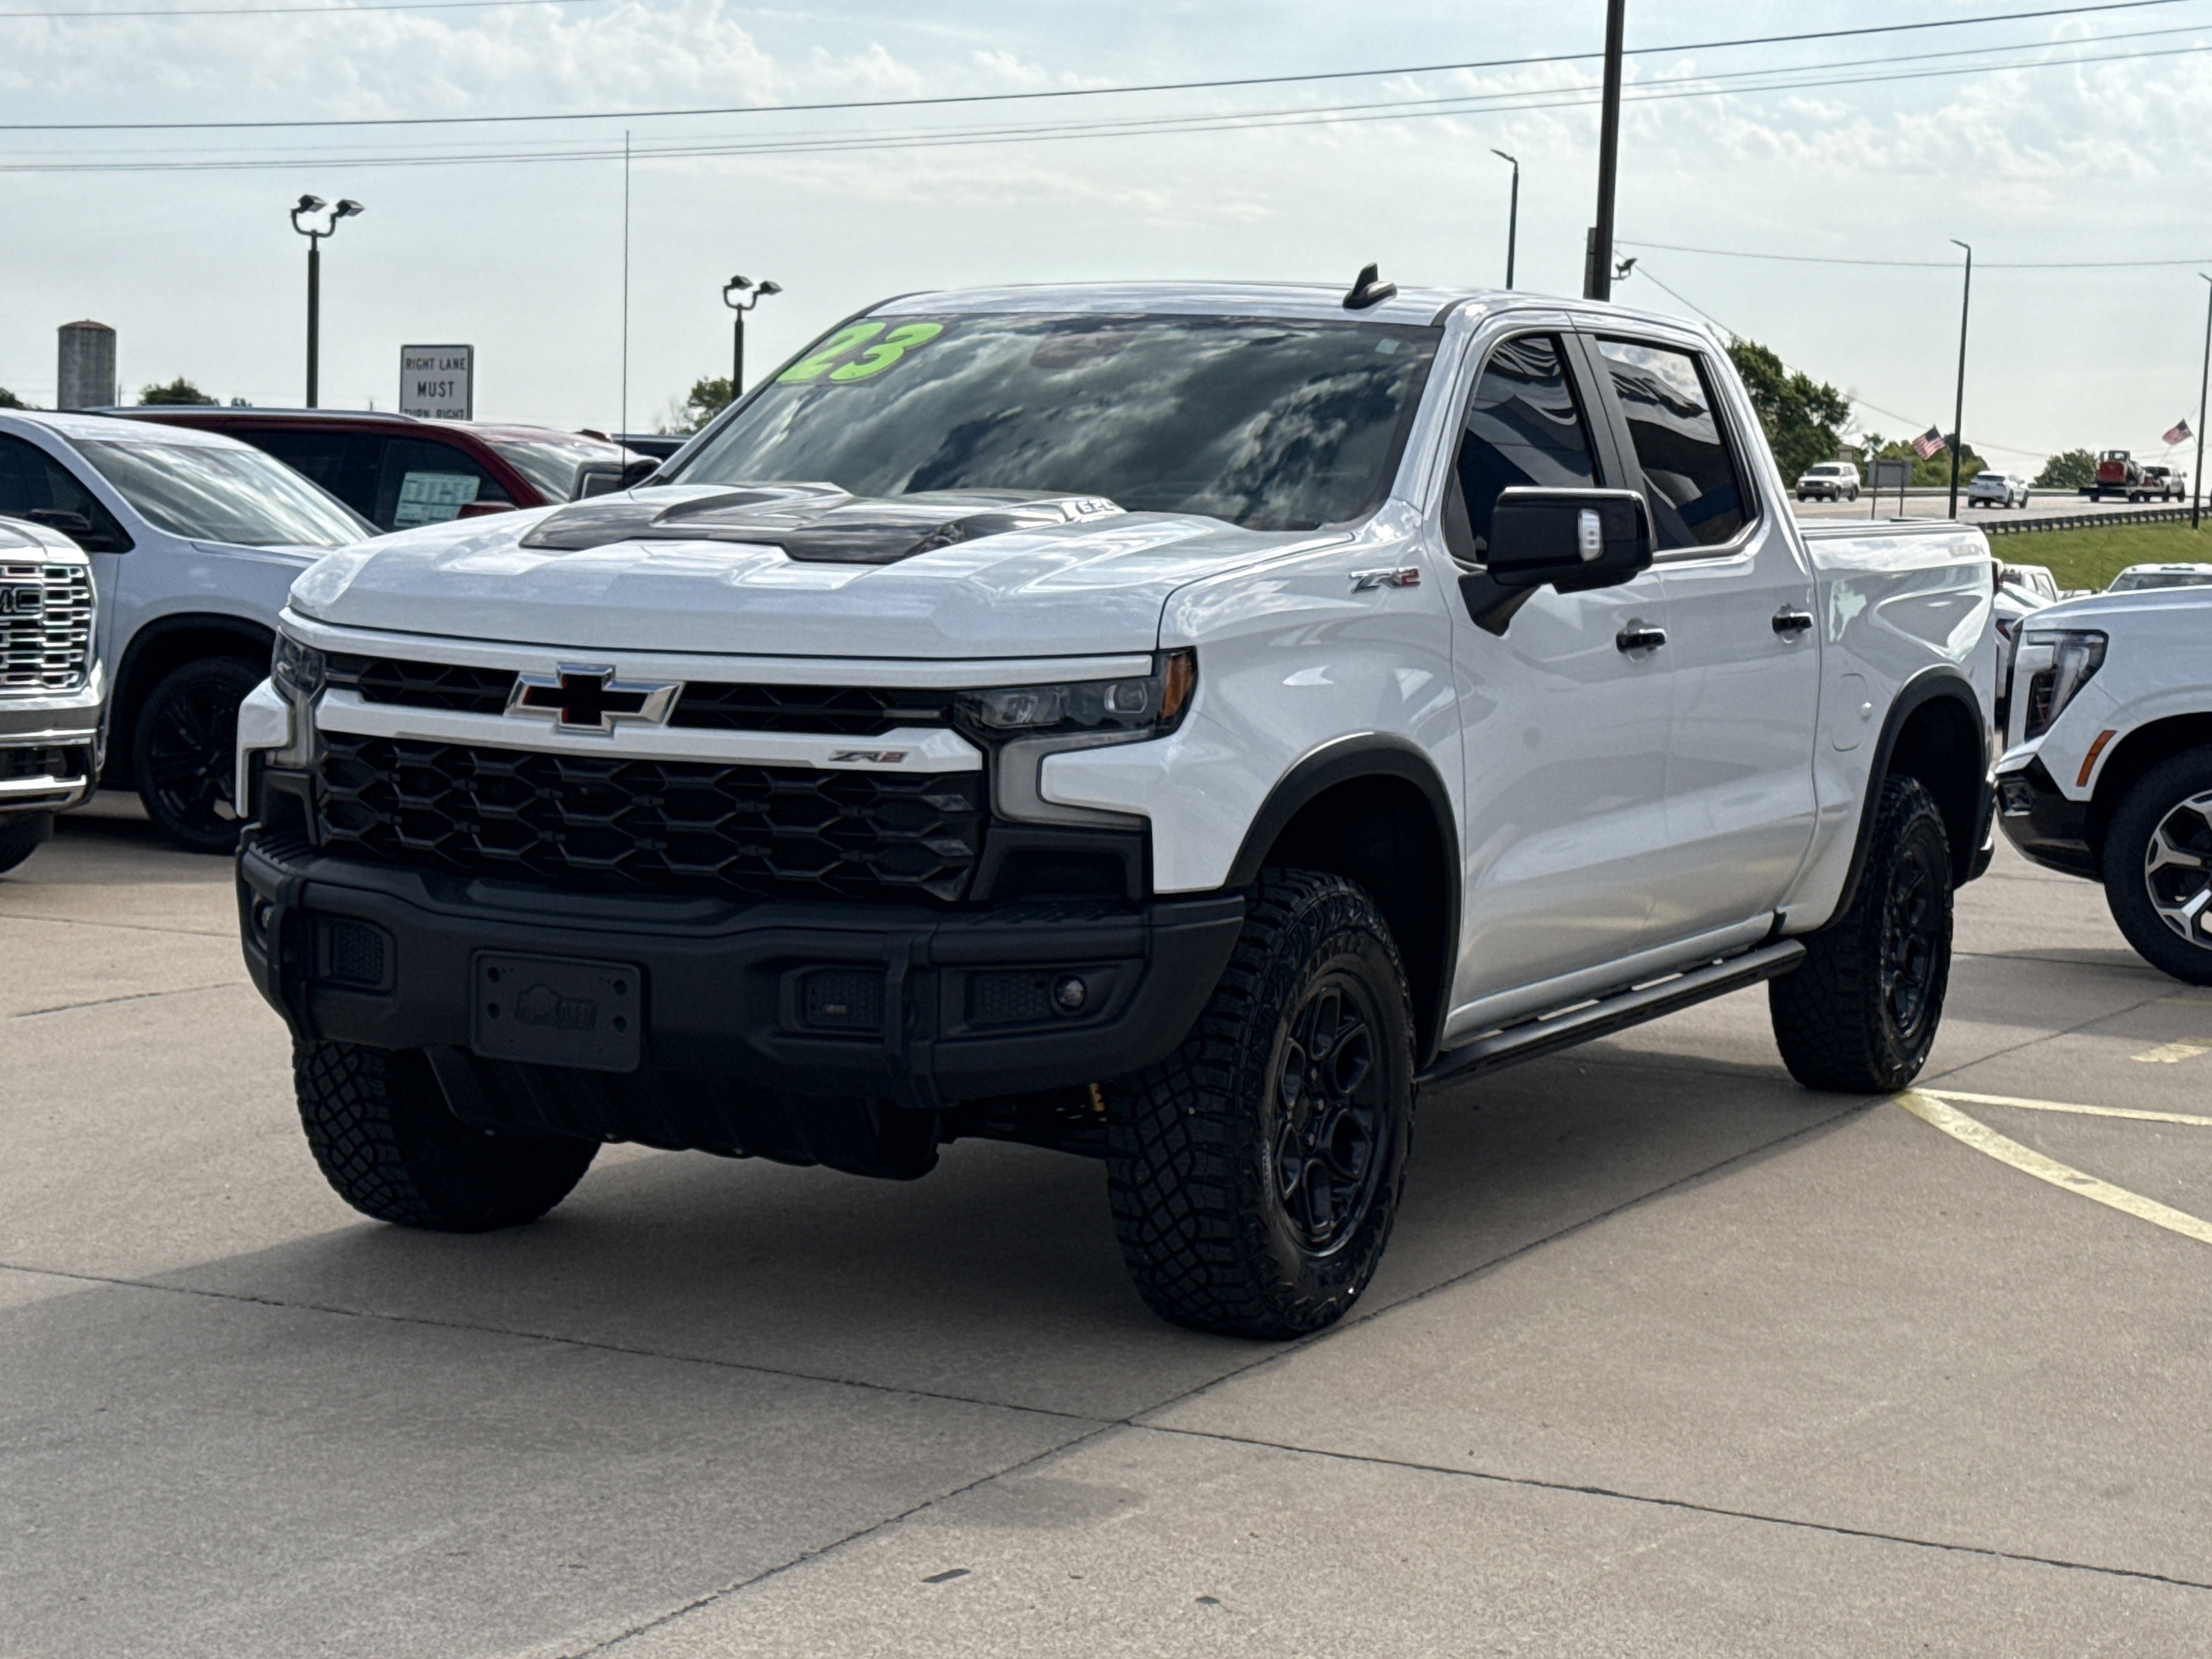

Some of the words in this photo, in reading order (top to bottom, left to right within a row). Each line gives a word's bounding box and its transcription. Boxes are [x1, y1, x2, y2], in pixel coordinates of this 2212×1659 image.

[775, 322, 944, 383] 23
[405, 358, 435, 370] RIGHT
[439, 358, 466, 370] LANE
[417, 381, 454, 397] MUST
[1349, 566, 1421, 594] ZR2
